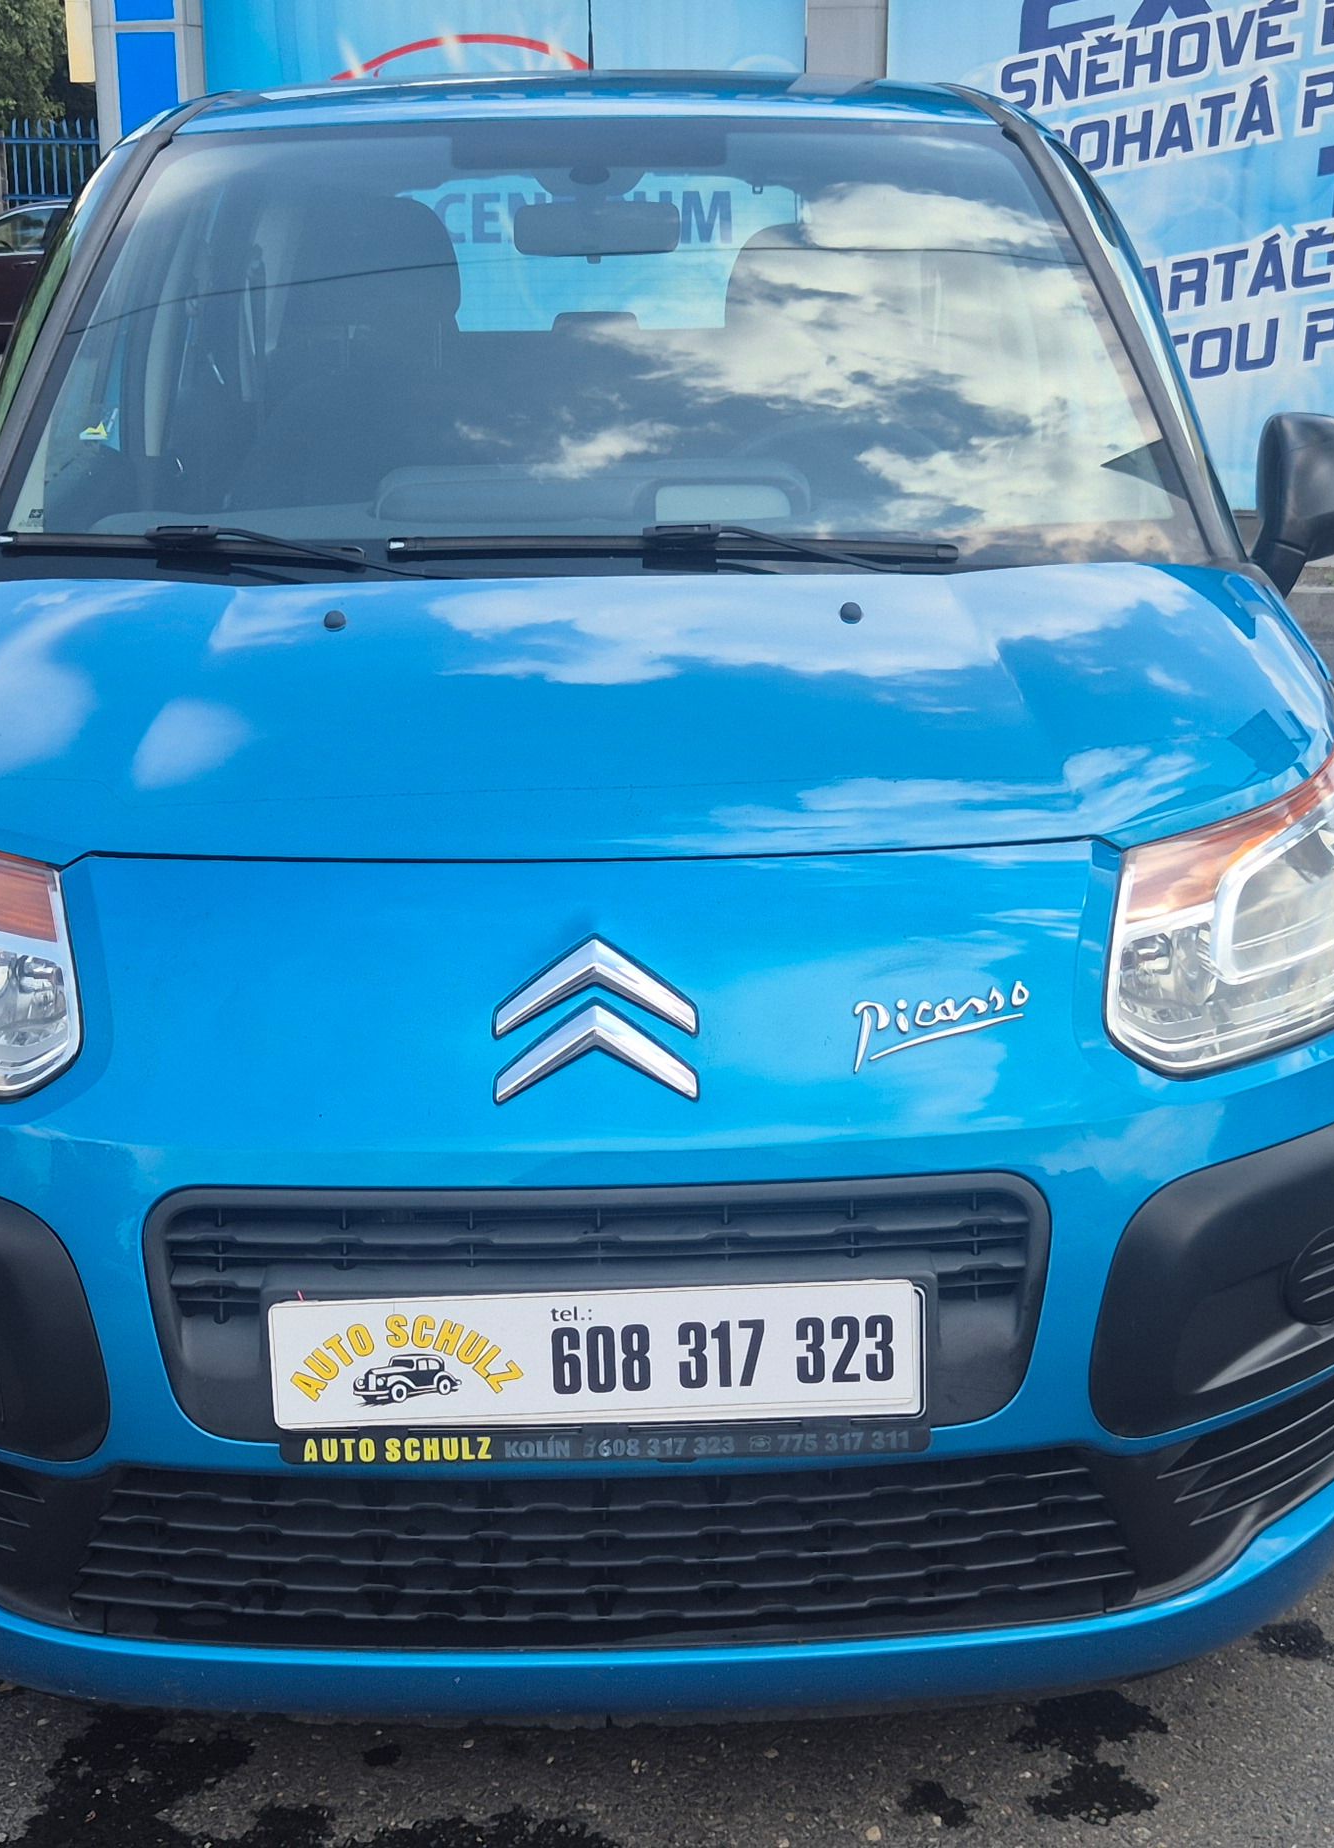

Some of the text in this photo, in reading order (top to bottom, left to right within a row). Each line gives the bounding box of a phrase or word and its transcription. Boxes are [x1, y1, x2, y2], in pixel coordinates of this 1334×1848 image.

[1054, 75, 1275, 172] OHATÁ
[551, 1306, 593, 1322] tel.:
[551, 1314, 894, 1395] 608 317 323
[290, 1314, 524, 1402] AUTO SCHULZ
[303, 1430, 910, 1462] AUTO SCHULZ KOLÍN 608 317 323 775 317 311
